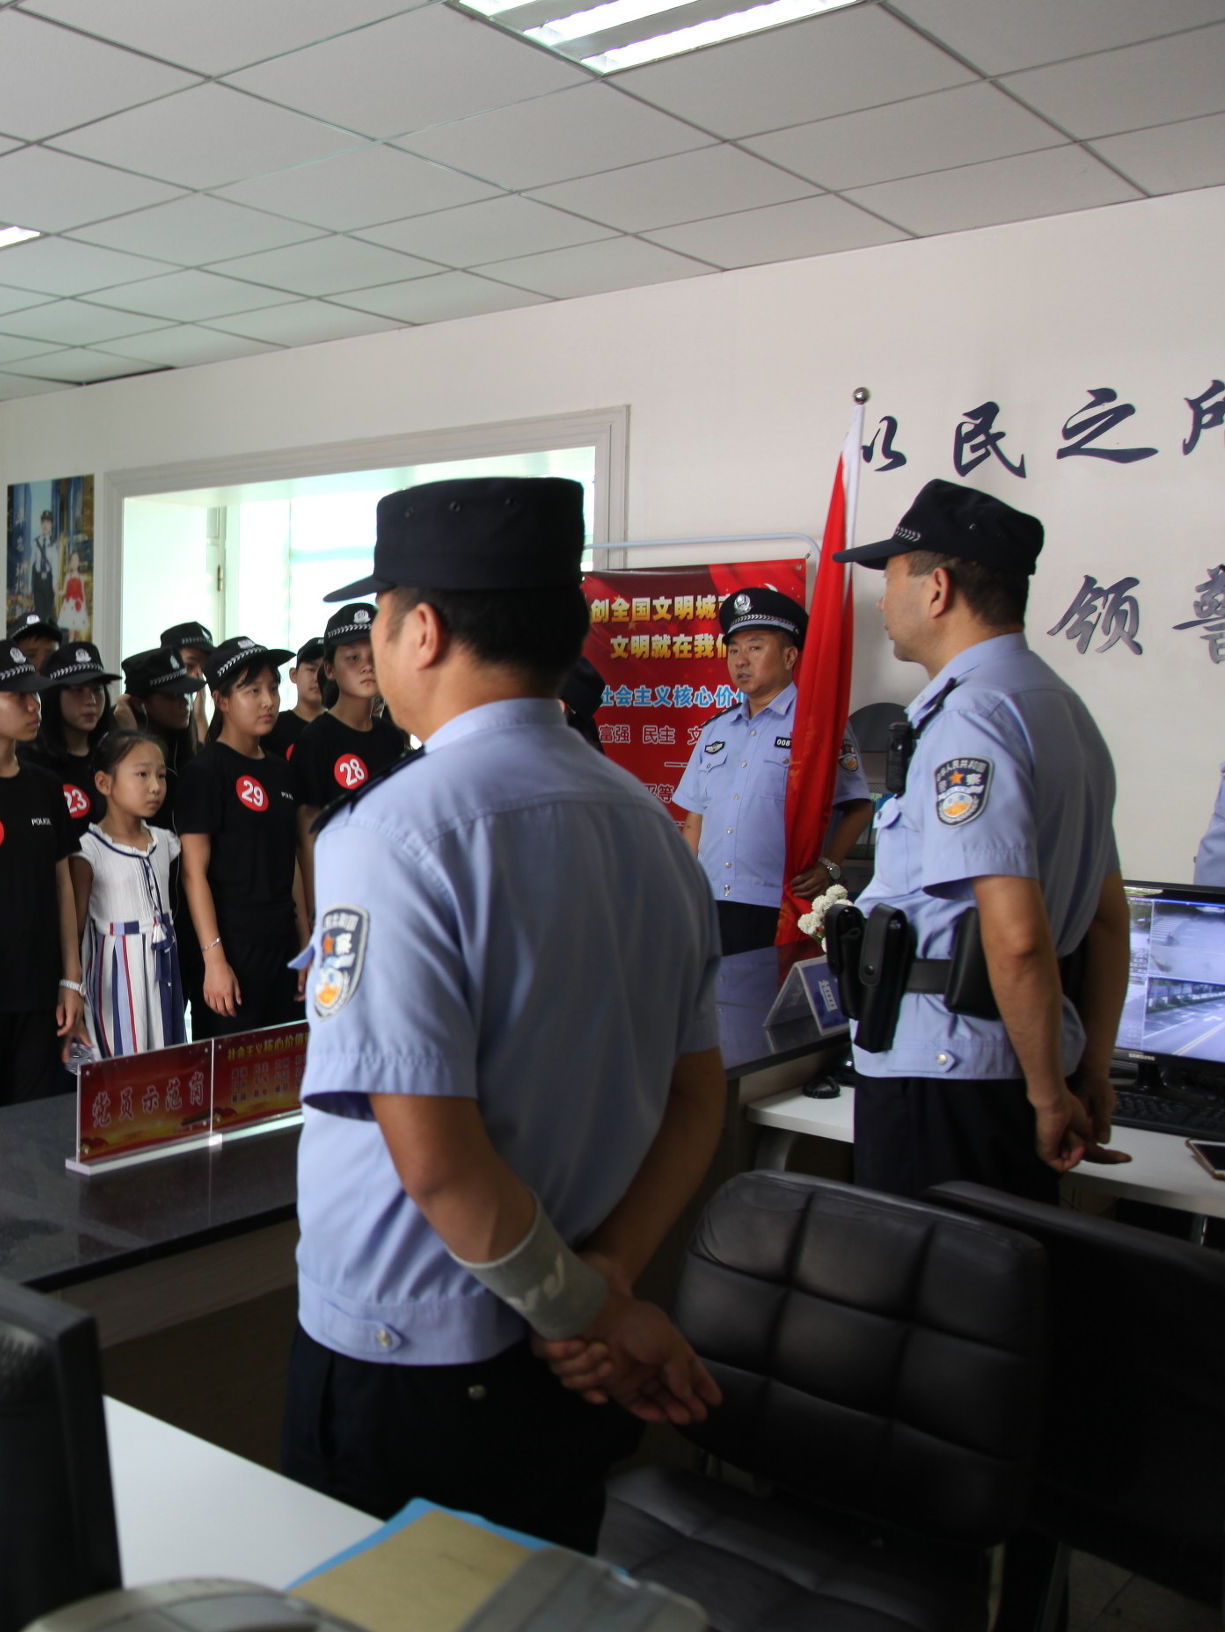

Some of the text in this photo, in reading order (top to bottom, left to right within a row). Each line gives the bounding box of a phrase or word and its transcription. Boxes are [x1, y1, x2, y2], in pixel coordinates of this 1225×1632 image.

[591, 594, 731, 623] 创全国文明城
[599, 724, 631, 744] 富强
[642, 725, 676, 744] 民主
[339, 758, 365, 786] 28
[241, 779, 264, 808] 29
[91, 1070, 205, 1129] 党员示范岗
